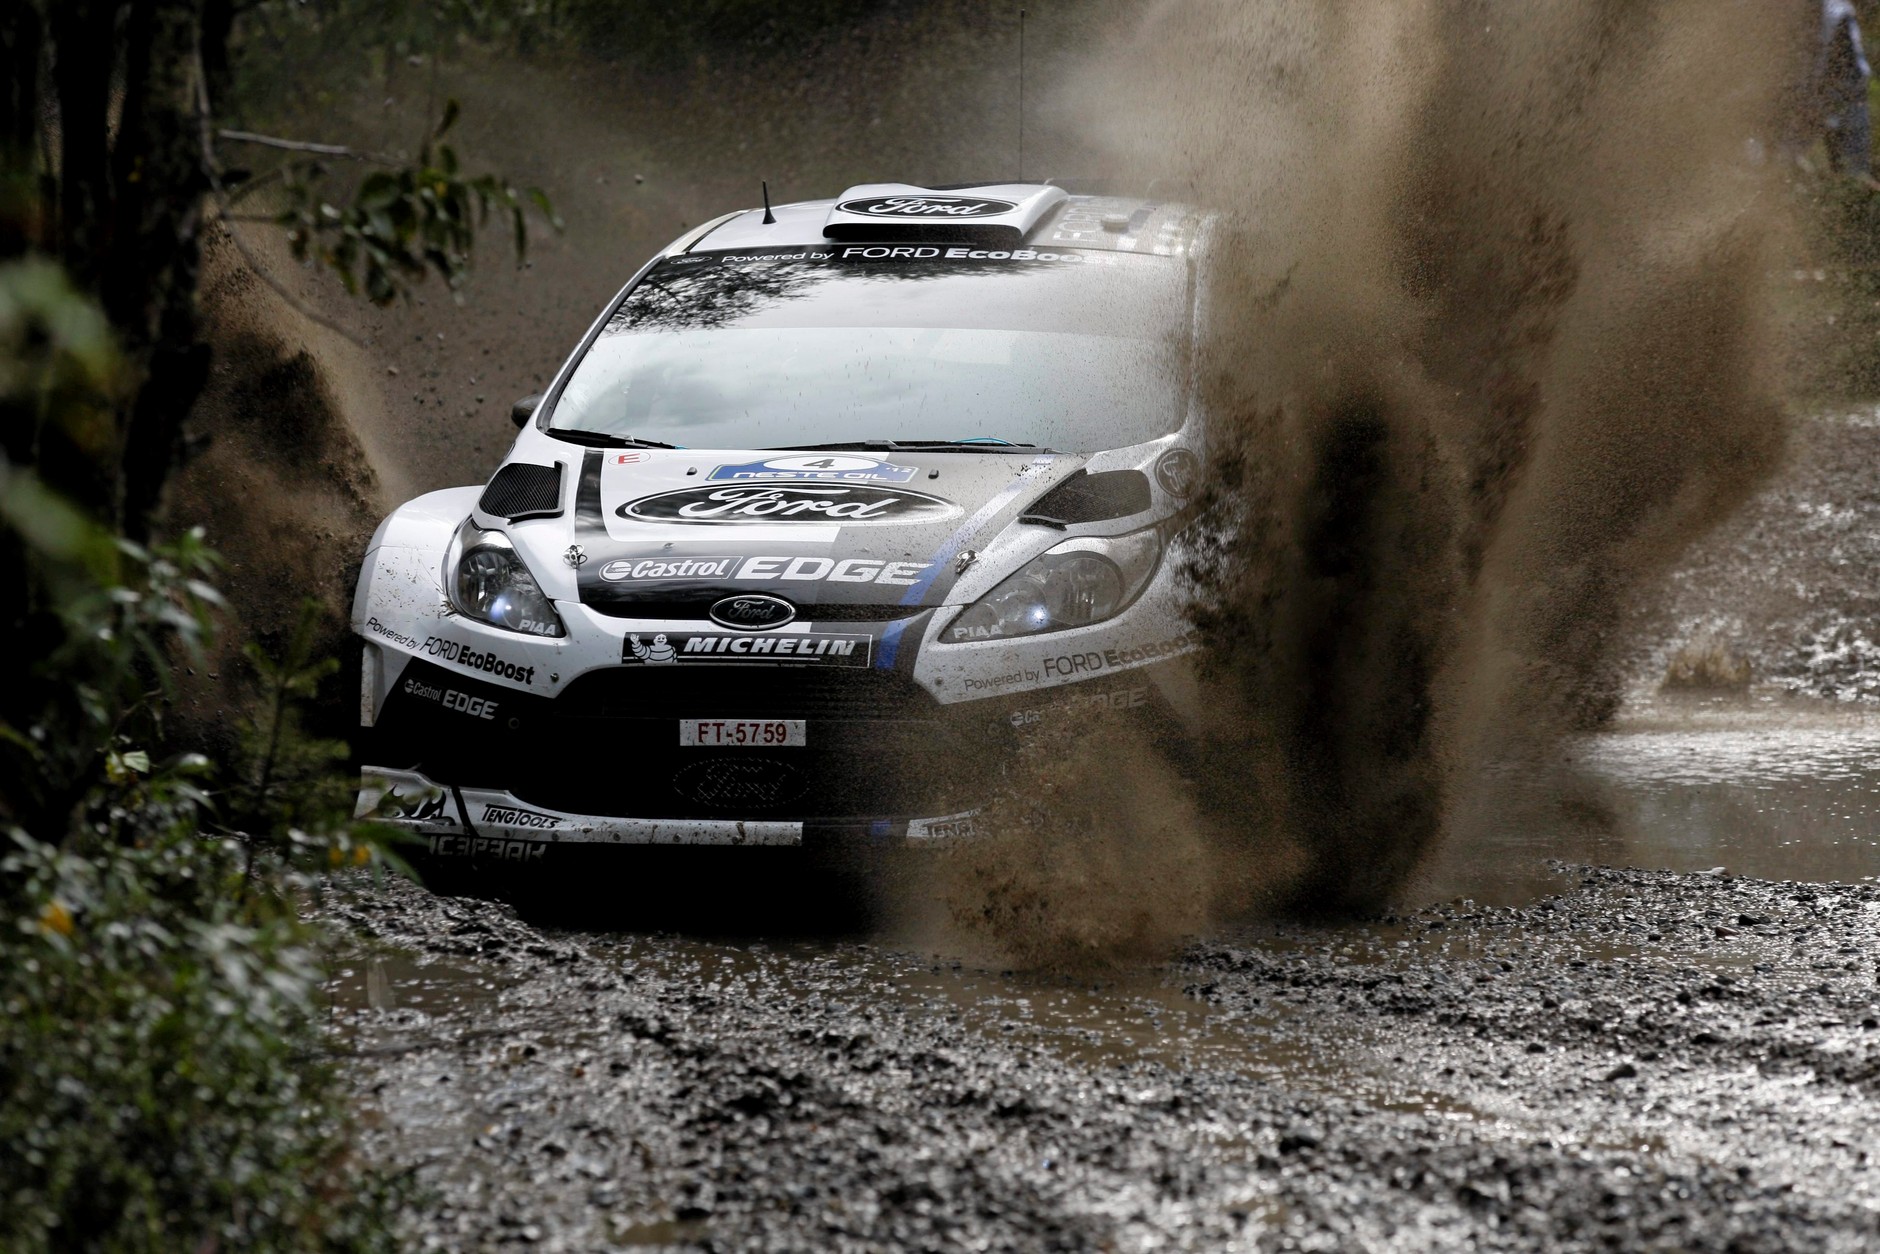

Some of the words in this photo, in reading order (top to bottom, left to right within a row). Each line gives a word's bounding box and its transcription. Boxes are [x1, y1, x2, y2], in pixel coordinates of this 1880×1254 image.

[868, 198, 988, 215] Ford
[721, 253, 806, 263] Powered
[810, 251, 834, 261] by
[842, 247, 940, 259] FORD
[803, 458, 836, 469] 4
[733, 471, 839, 479] NESTE
[843, 472, 888, 480] OIL
[678, 486, 901, 519] Ford
[631, 557, 726, 577] Castrol
[736, 556, 934, 585] EDGE
[727, 600, 775, 620] Ford
[518, 619, 556, 636] PIAA
[953, 623, 1002, 639] PIAA
[366, 616, 409, 648] Powered
[406, 637, 420, 650] by
[419, 636, 458, 661] FORD
[457, 646, 535, 685] EcoBoost
[683, 636, 857, 656] MICHELIN
[964, 671, 1023, 691] Powered
[1024, 668, 1040, 683] by
[1044, 652, 1101, 677] FORD
[413, 682, 443, 701] Castrol
[443, 690, 499, 719] EDGE
[698, 722, 787, 744] FT-5759
